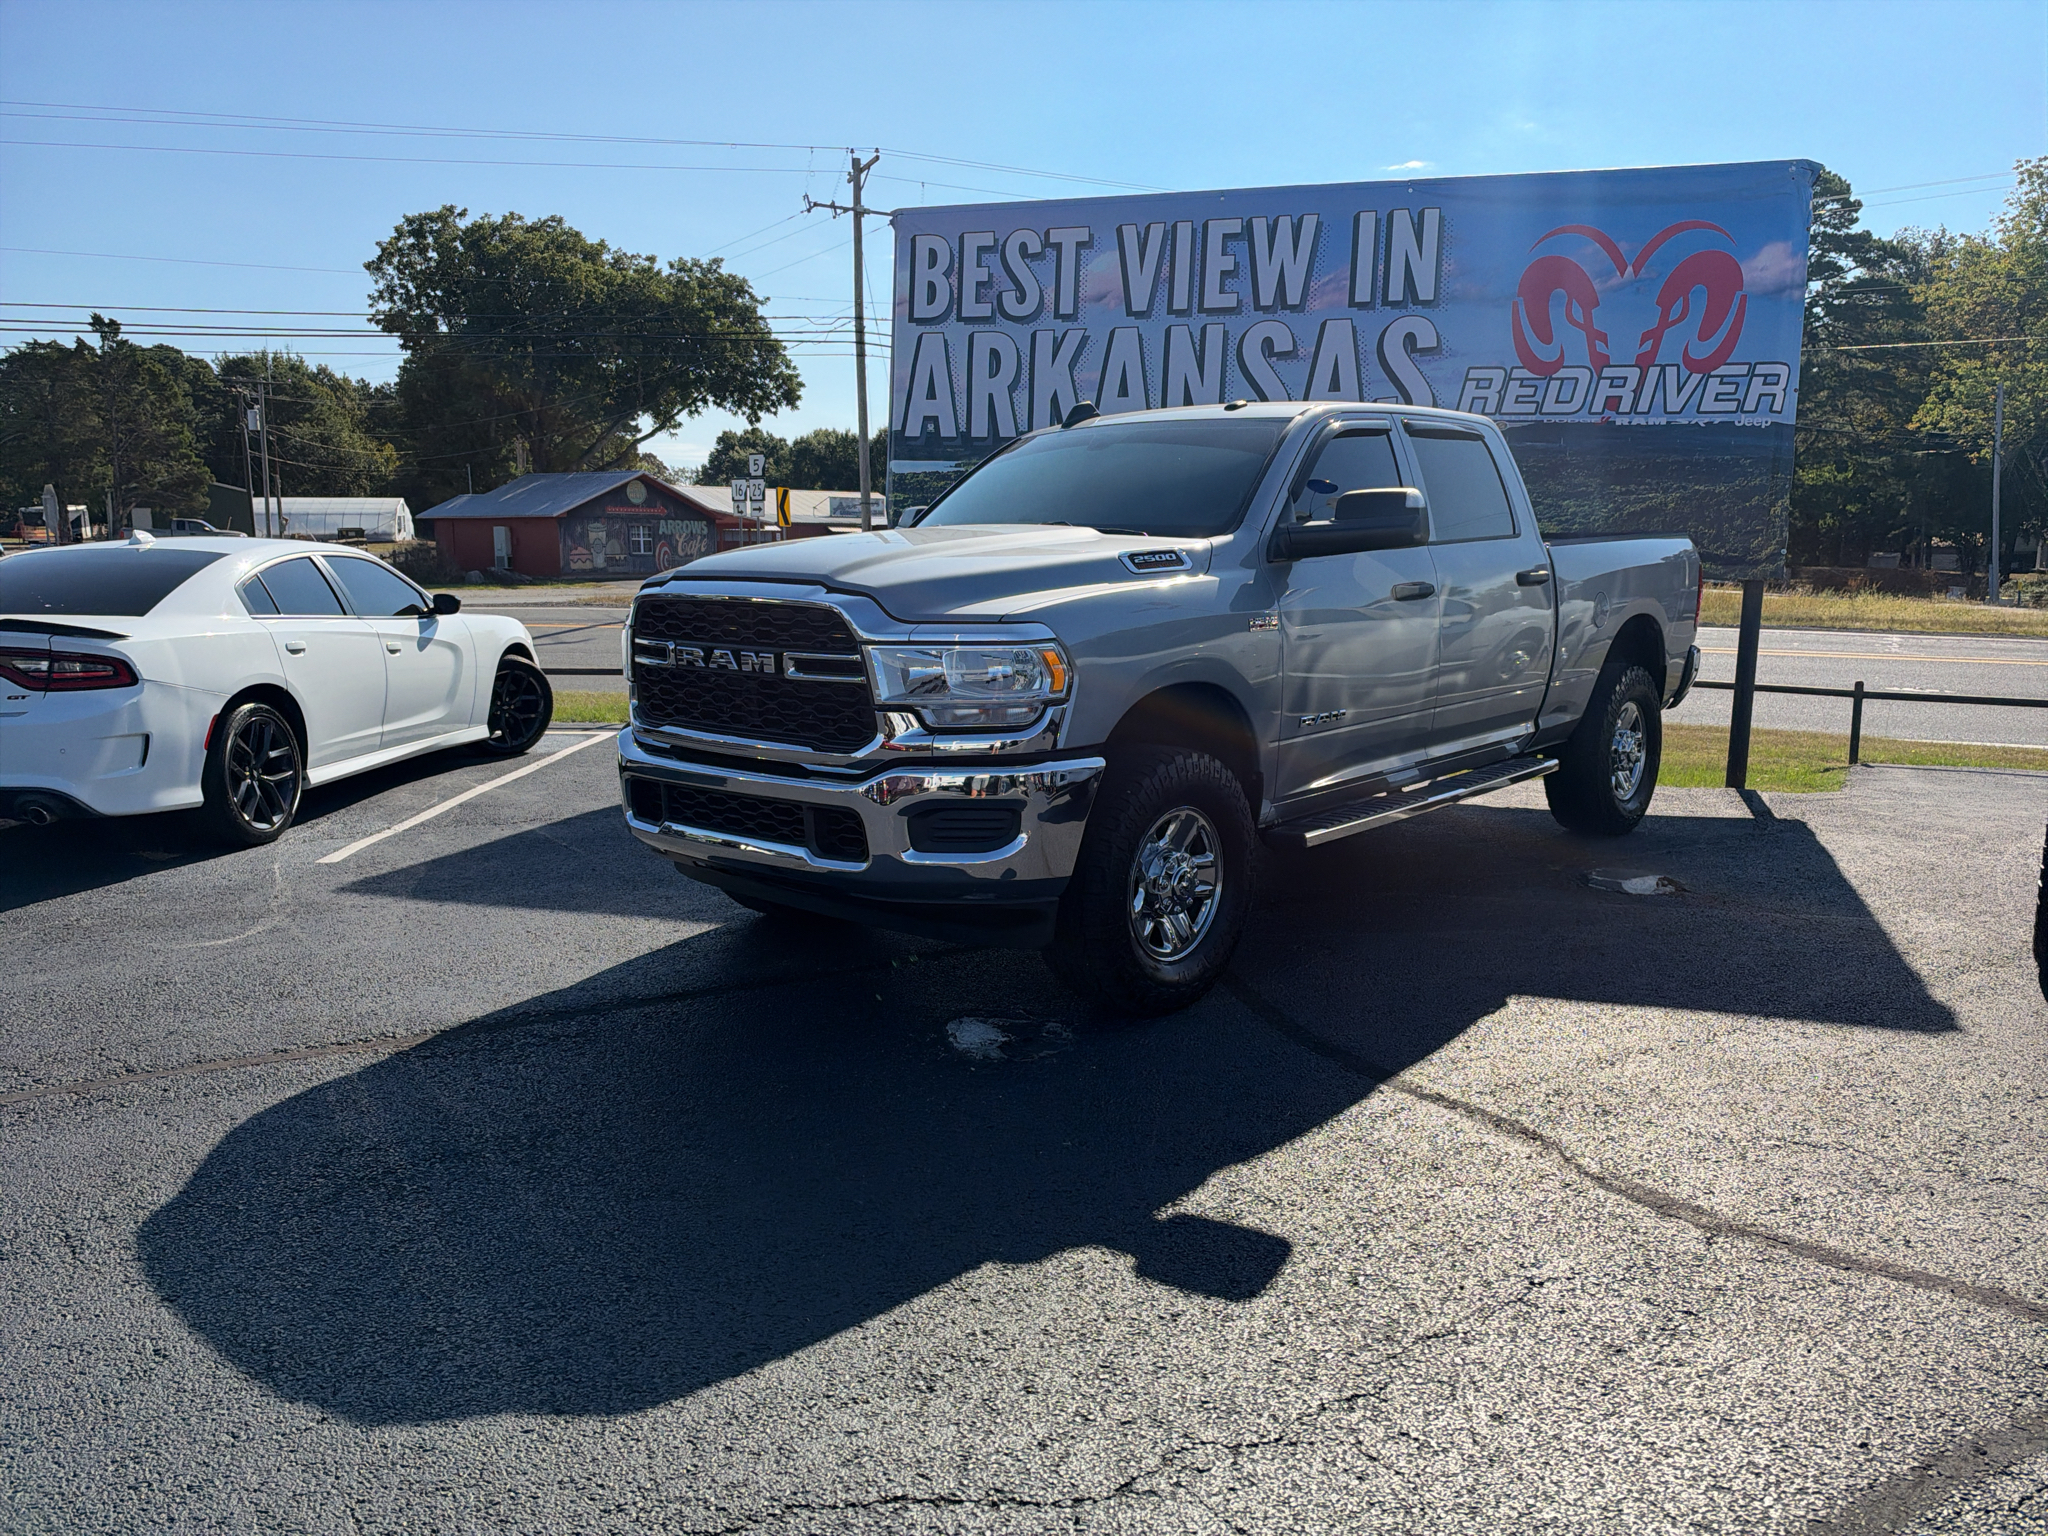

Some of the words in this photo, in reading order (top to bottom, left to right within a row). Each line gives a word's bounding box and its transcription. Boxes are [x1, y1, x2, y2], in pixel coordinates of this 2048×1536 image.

[908, 225, 1091, 324] BEST
[1116, 213, 1321, 318] VIEW
[1348, 206, 1442, 309] IN
[900, 314, 1441, 439] ARKANSAS
[1615, 417, 1667, 426] RAM
[1734, 414, 1772, 429] Jeep
[753, 458, 760, 472] 5
[735, 484, 744, 497] 16
[752, 484, 762, 497] 25
[659, 519, 708, 535] ARROWS
[1133, 553, 1177, 564] 2500
[676, 646, 776, 674] RAM
[1299, 709, 1347, 727] RAM
